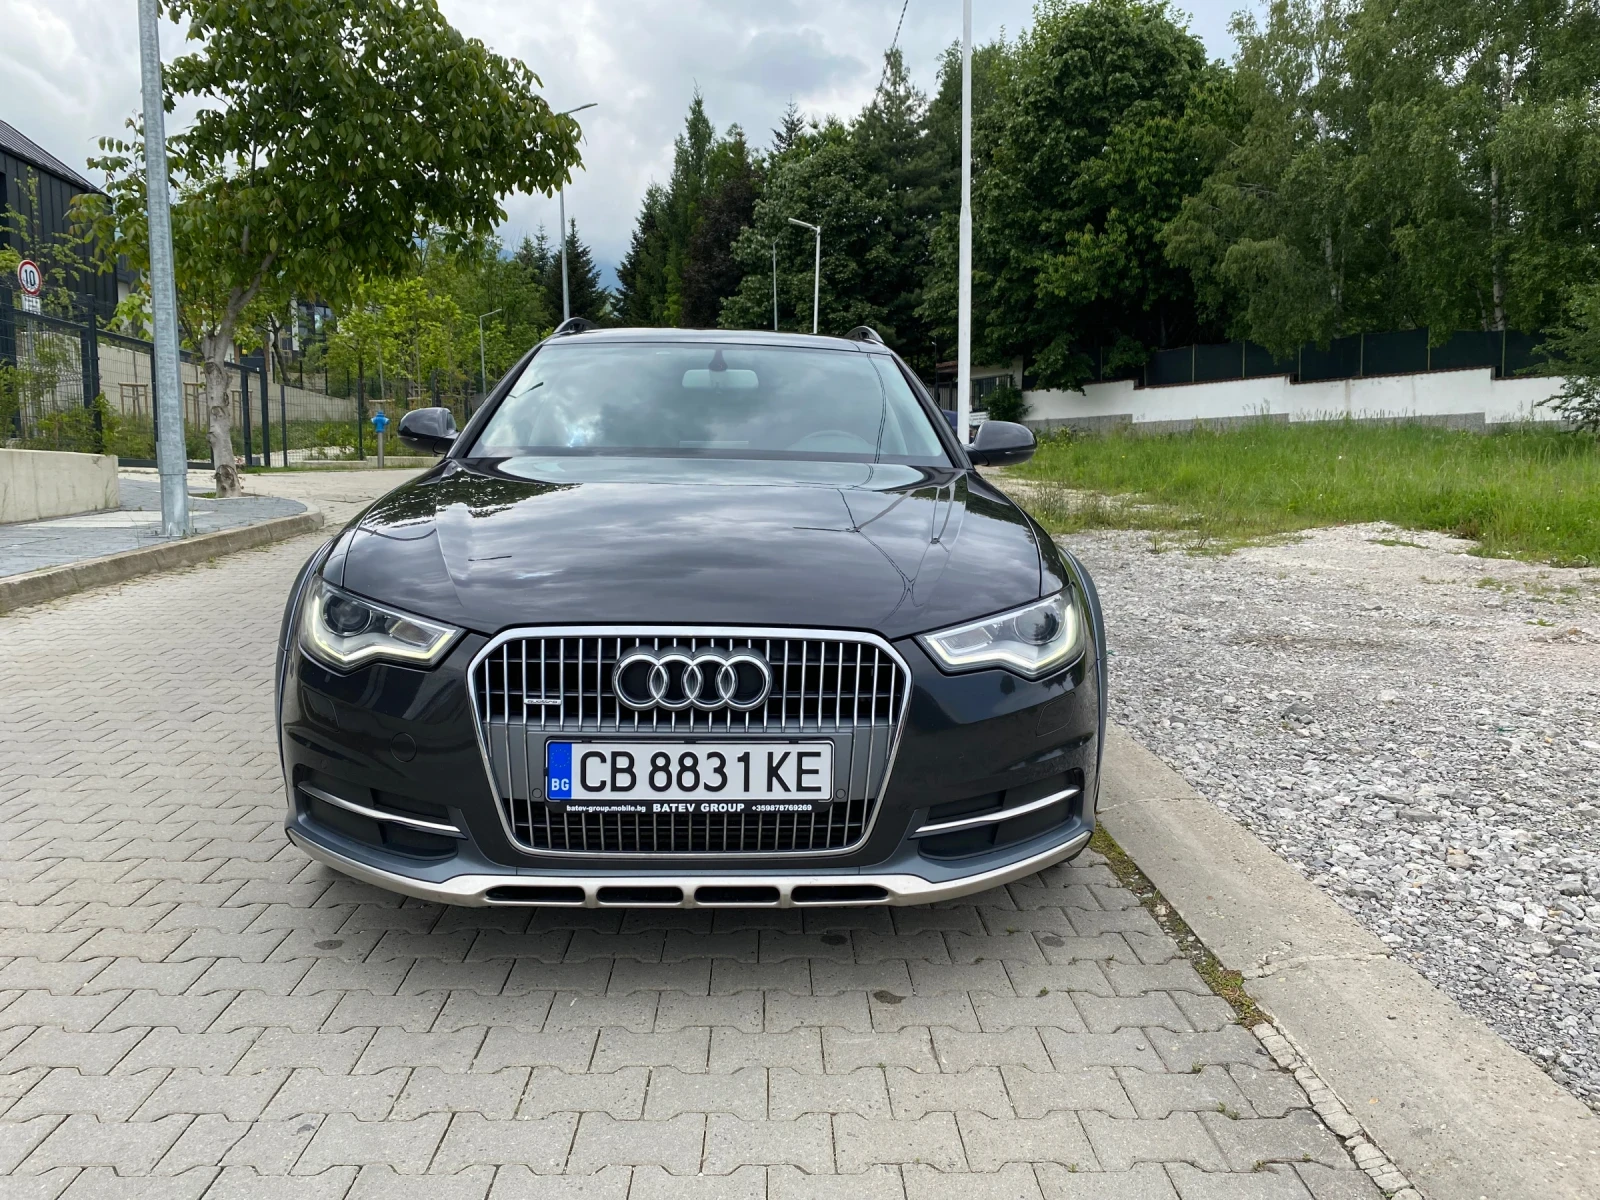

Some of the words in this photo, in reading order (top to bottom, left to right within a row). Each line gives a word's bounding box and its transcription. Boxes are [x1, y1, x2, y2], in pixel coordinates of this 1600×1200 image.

[24, 269, 36, 287] 10
[580, 751, 637, 792] CB
[649, 751, 750, 792] 8831
[767, 751, 822, 792] KE
[551, 778, 570, 791] BG
[566, 805, 646, 813] batev-group.mobile.bg
[653, 803, 695, 812] BATEV
[701, 803, 745, 812] GROUP
